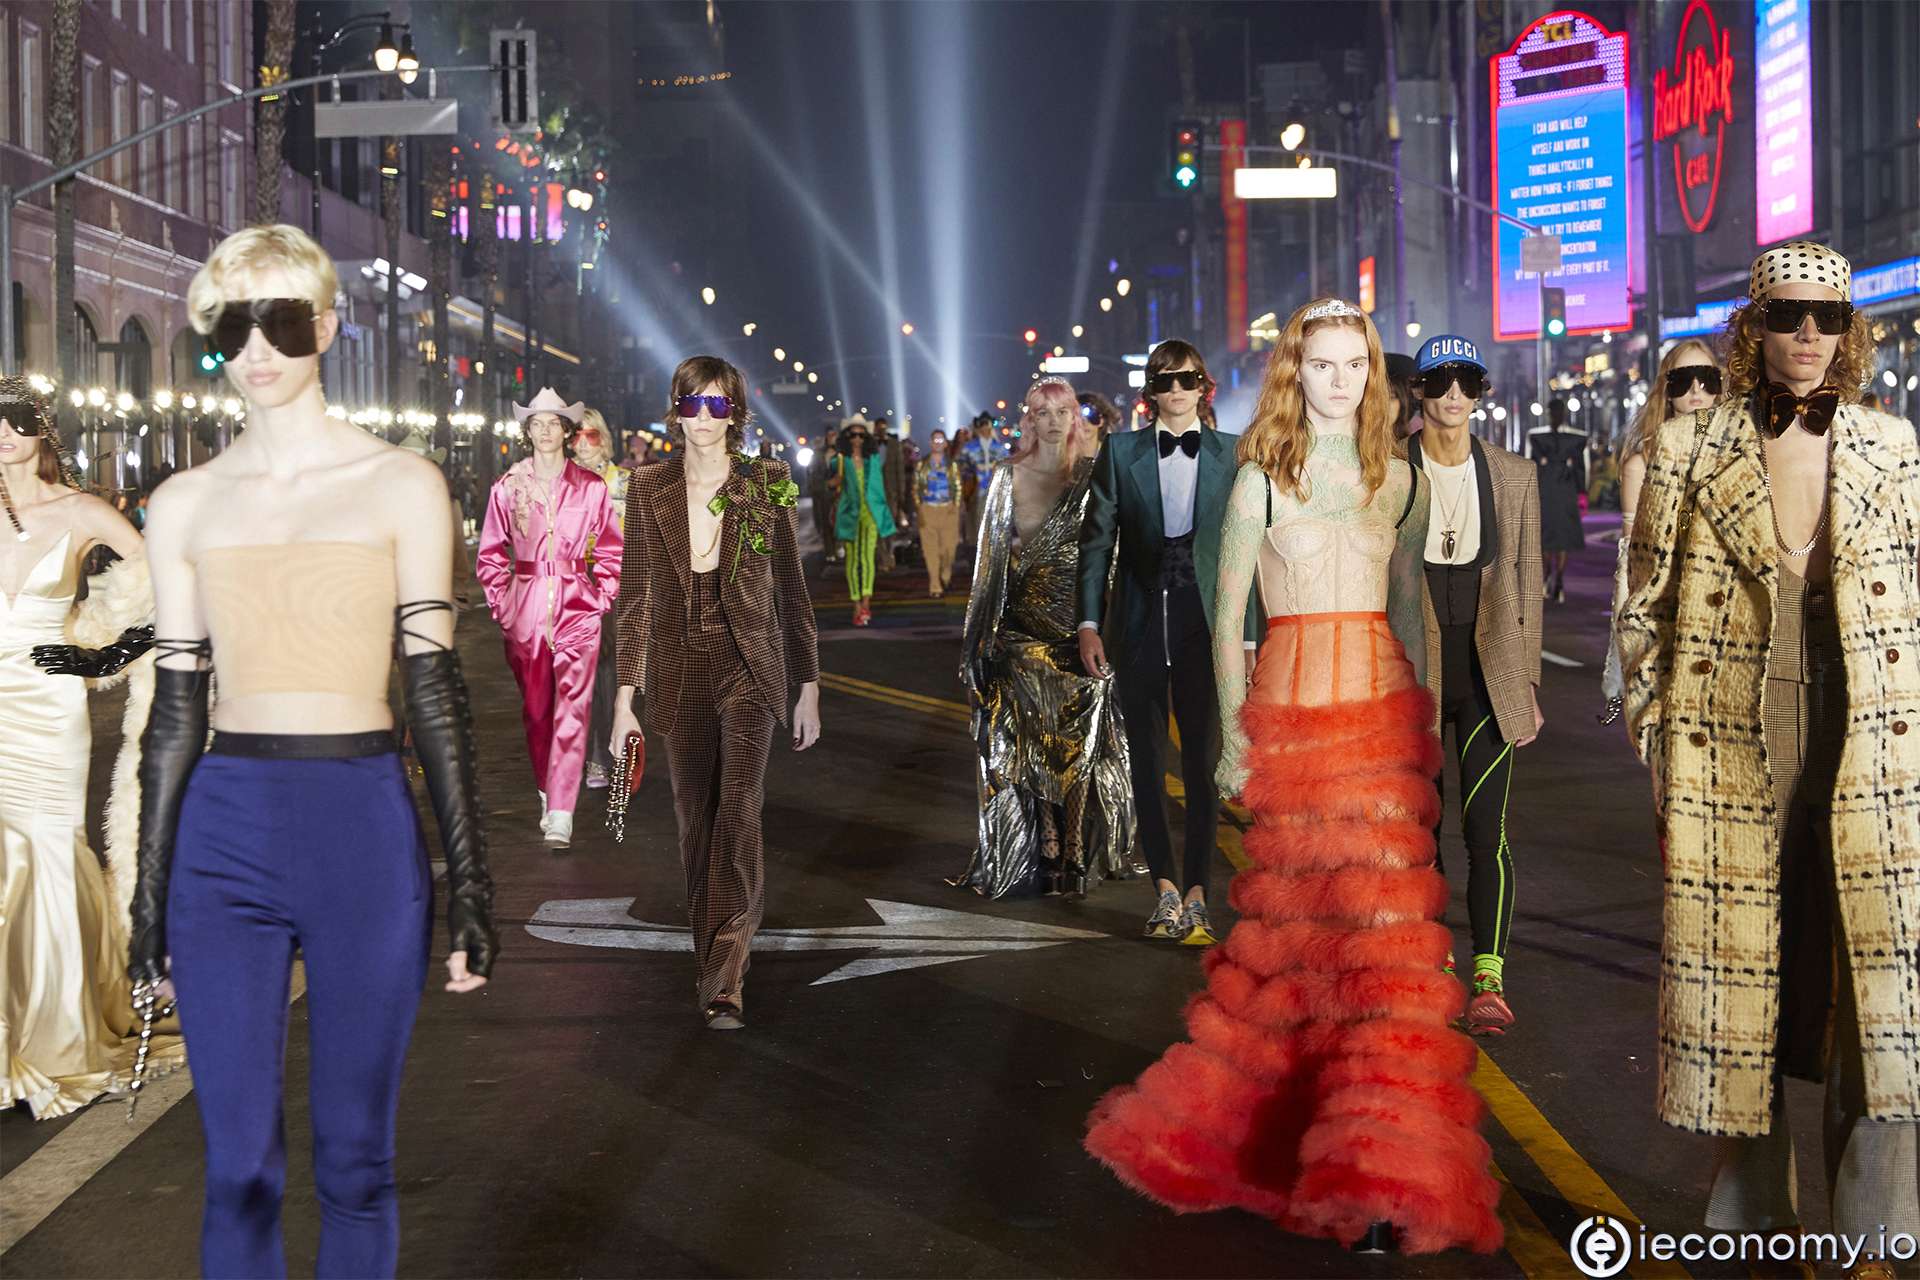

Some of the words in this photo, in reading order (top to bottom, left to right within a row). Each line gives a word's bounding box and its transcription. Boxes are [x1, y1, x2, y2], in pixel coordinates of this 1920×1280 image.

[1693, 28, 1734, 137] Rock
[1536, 121, 1547, 135] CAN
[1548, 119, 1559, 134] AND
[1560, 118, 1574, 132] WILL
[1574, 115, 1588, 129] HELP
[1531, 141, 1552, 156] MYSELF
[1553, 140, 1564, 153] AND
[1565, 137, 1581, 151] WORK
[1528, 163, 1547, 177] THINGS
[1547, 158, 1585, 175] ANALYTICALLY
[1510, 186, 1530, 200] MATTER
[1594, 176, 1613, 189] THINGS
[1528, 203, 1562, 218] UNCONSCIOUS
[1562, 200, 1580, 214] WANTS
[1431, 339, 1477, 361] GUCCI
